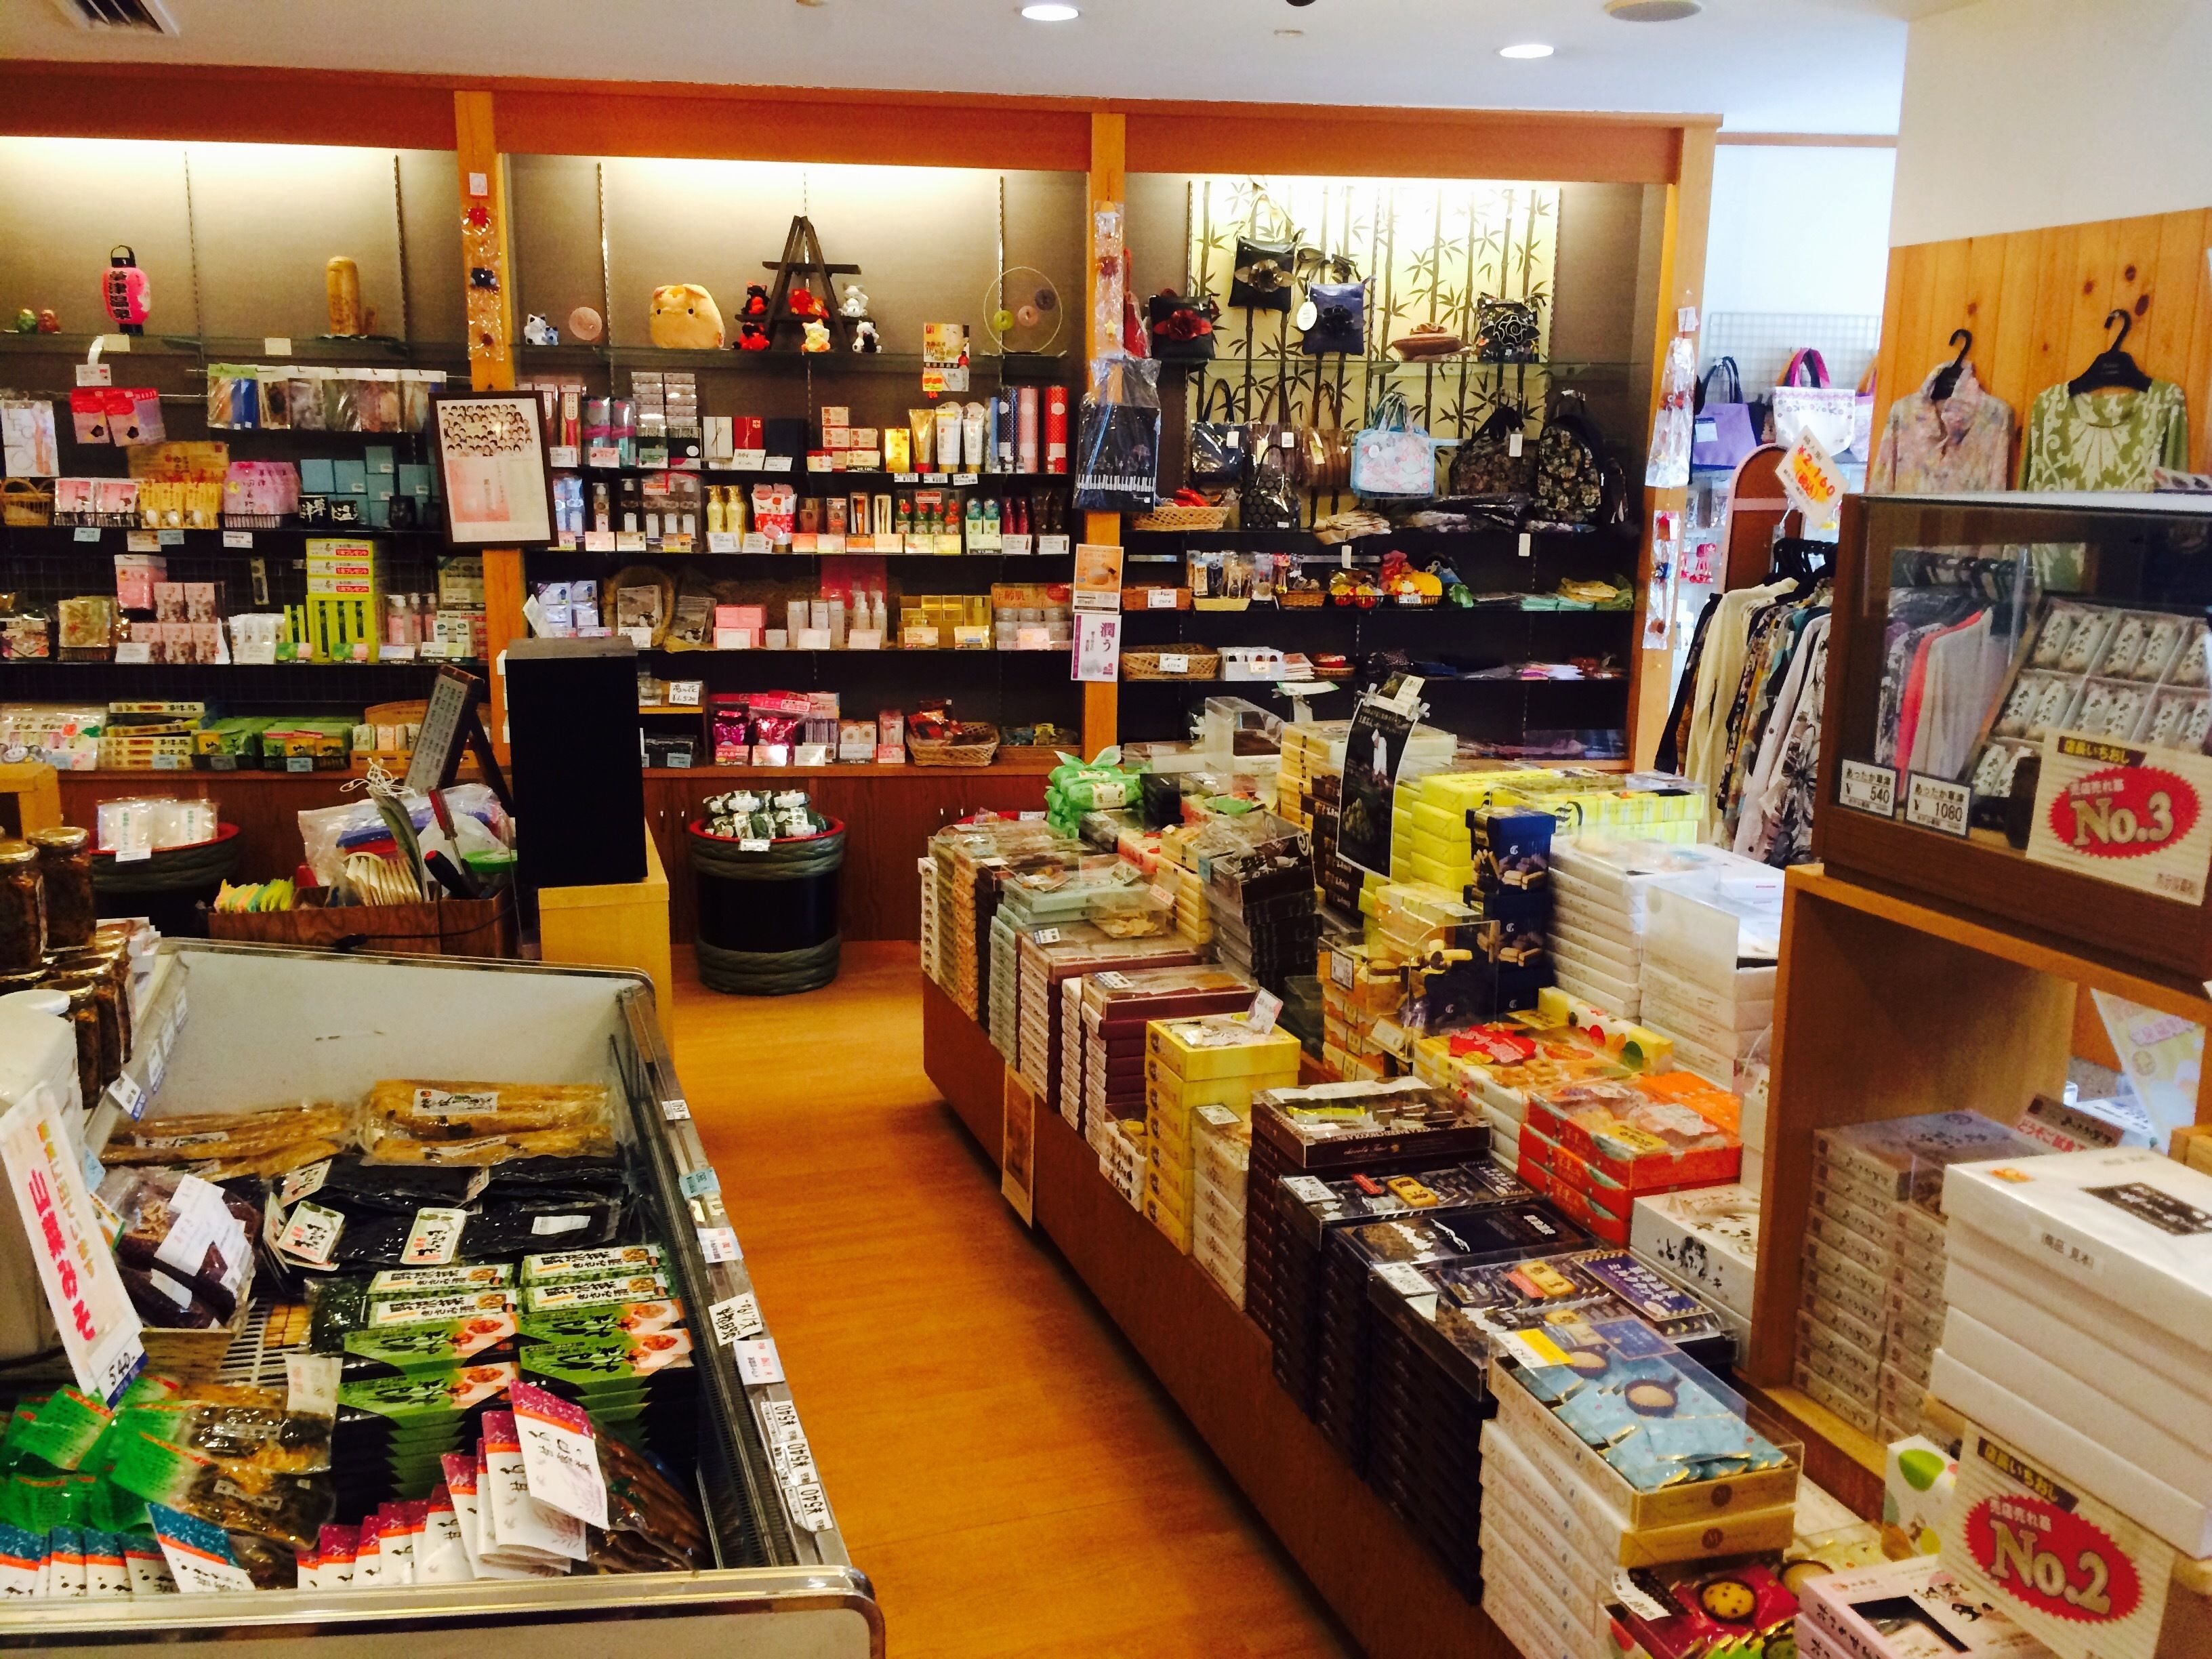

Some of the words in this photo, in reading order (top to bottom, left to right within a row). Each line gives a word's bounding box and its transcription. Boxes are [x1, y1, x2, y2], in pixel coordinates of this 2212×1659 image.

[108, 271, 132, 319] 草津温泉
[1100, 622, 1115, 652] 潤う
[1870, 786, 1890, 804] 540
[2070, 792, 2173, 846] No.3
[775, 1406, 796, 1429] ¥540
[790, 1442, 808, 1468] ¥540
[800, 1489, 823, 1516] ¥540
[1990, 1519, 2111, 1615] No.2
